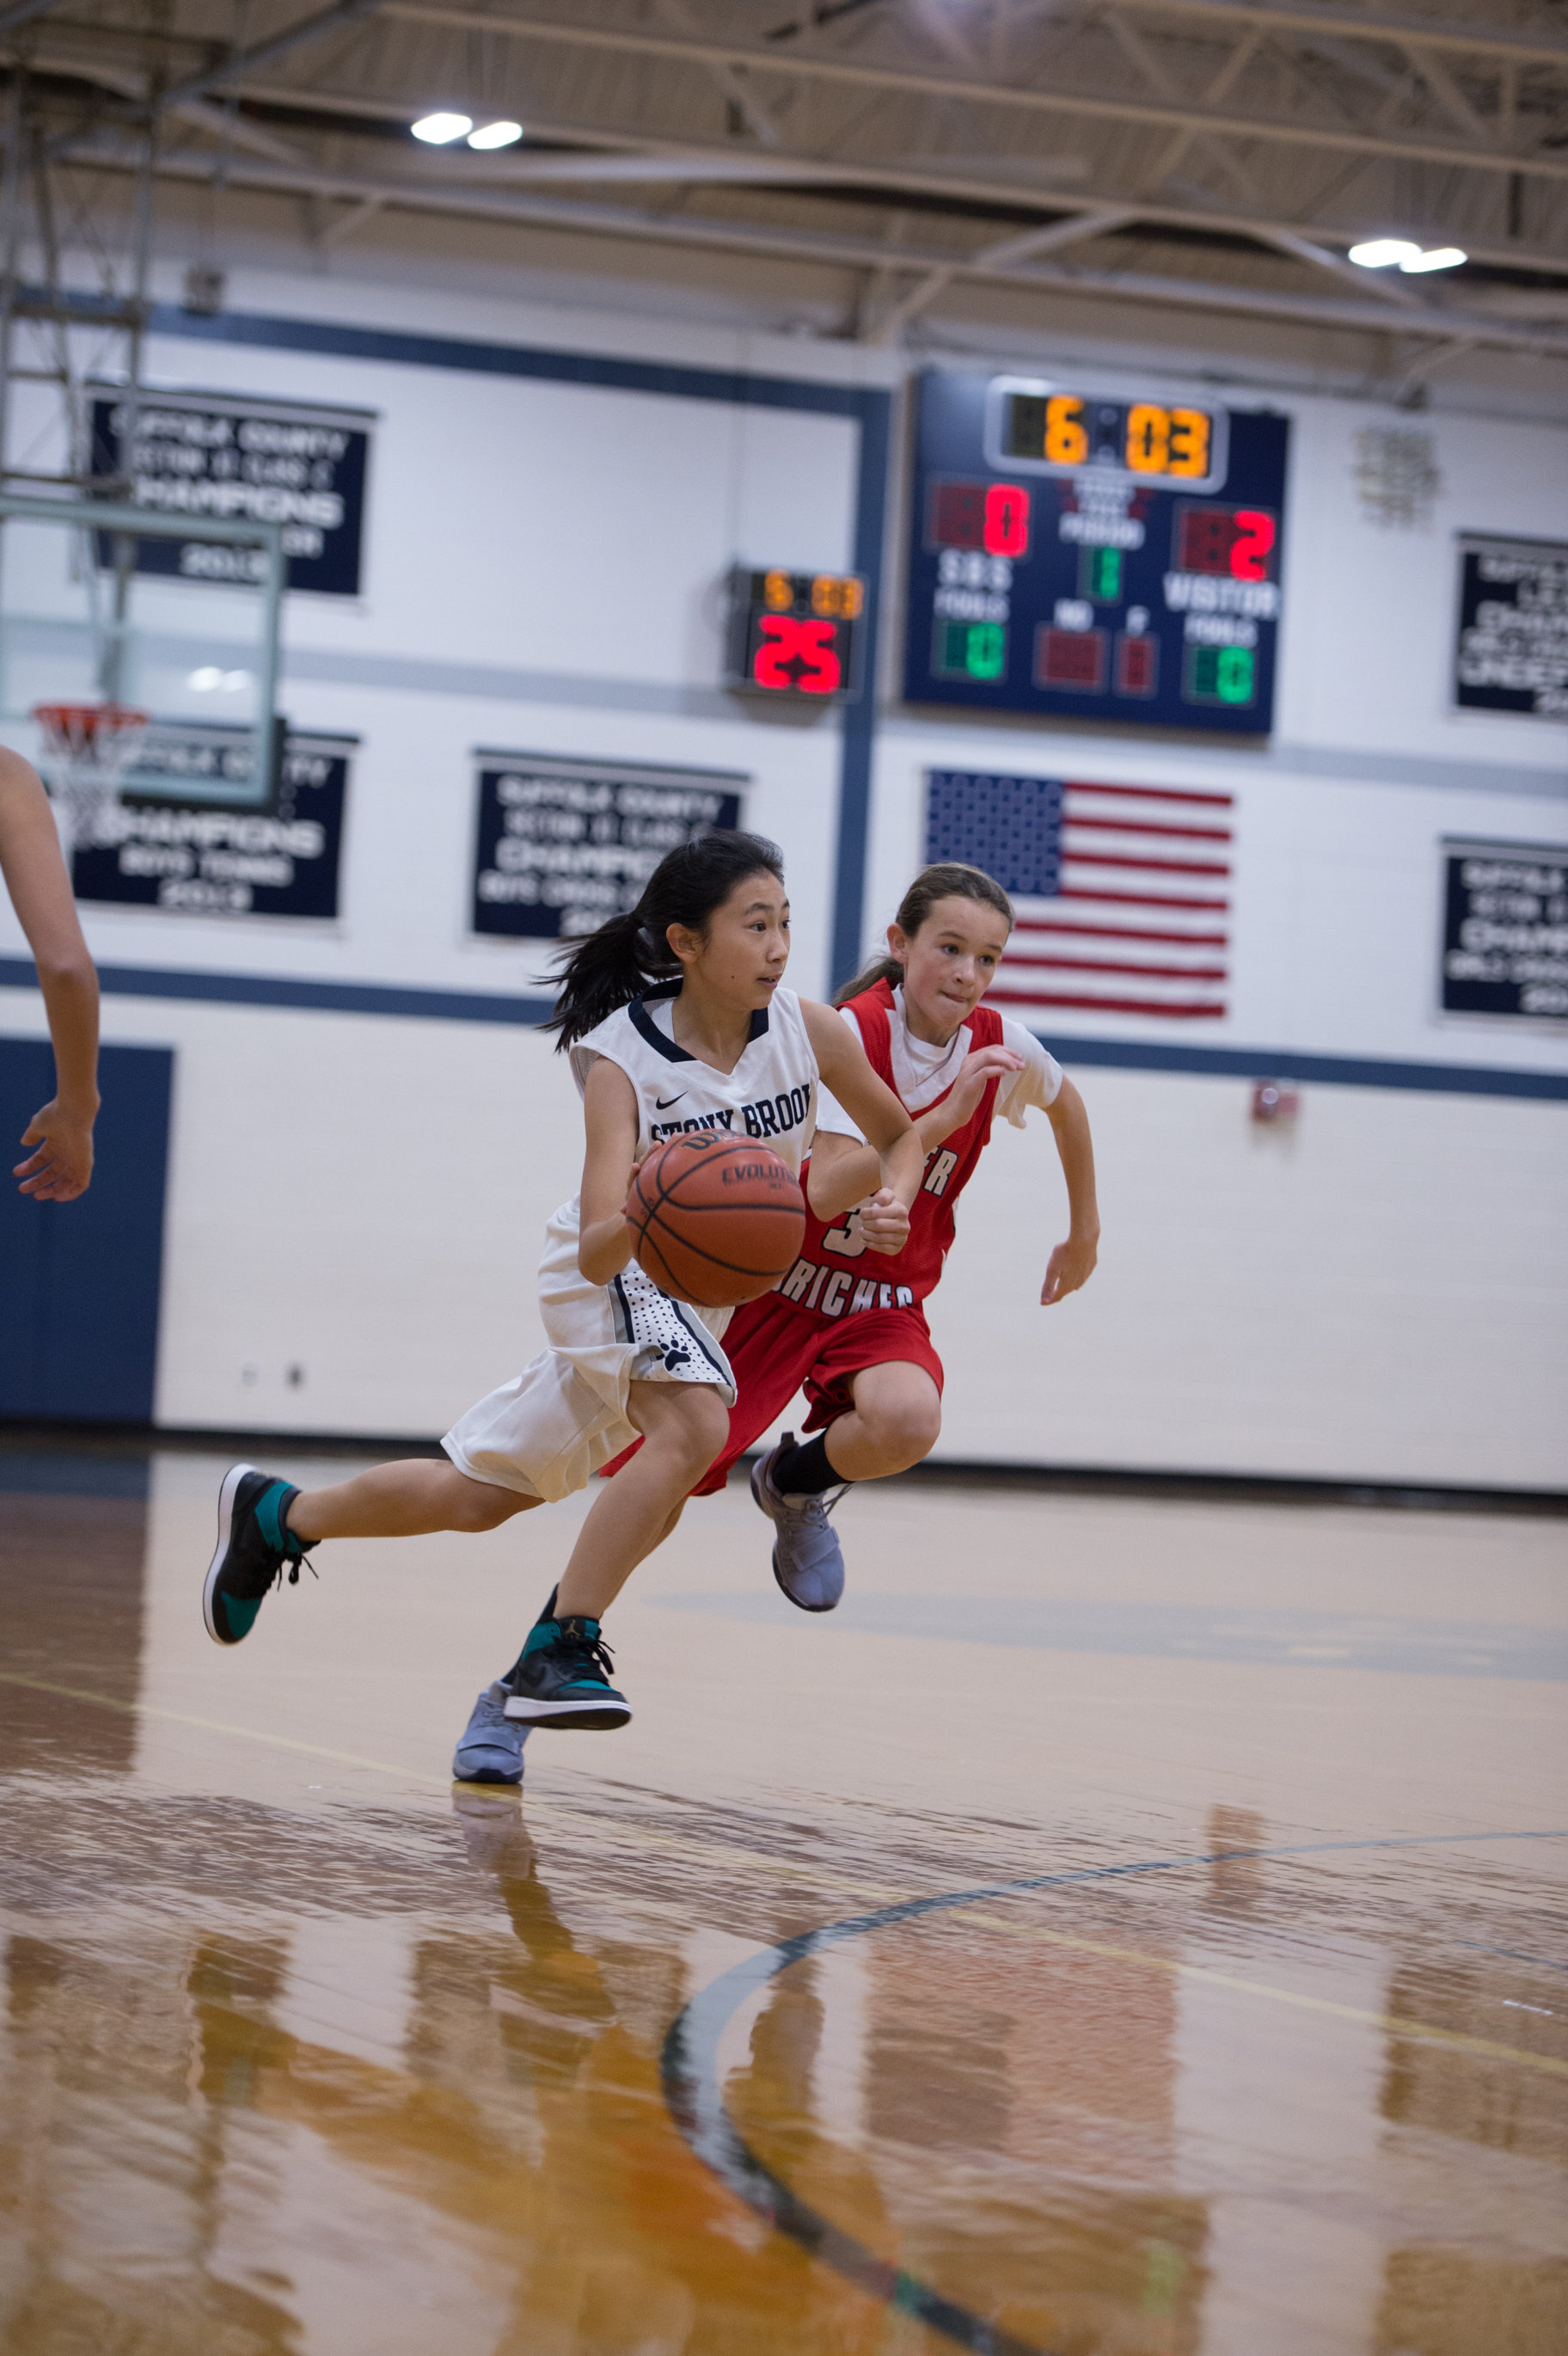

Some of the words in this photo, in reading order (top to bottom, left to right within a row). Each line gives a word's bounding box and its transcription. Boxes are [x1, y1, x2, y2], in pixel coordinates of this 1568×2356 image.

[132, 476, 344, 530] HAMPIONS
[1230, 511, 1275, 582] 2
[754, 615, 841, 695] 25
[771, 1258, 913, 1317] RICHE
